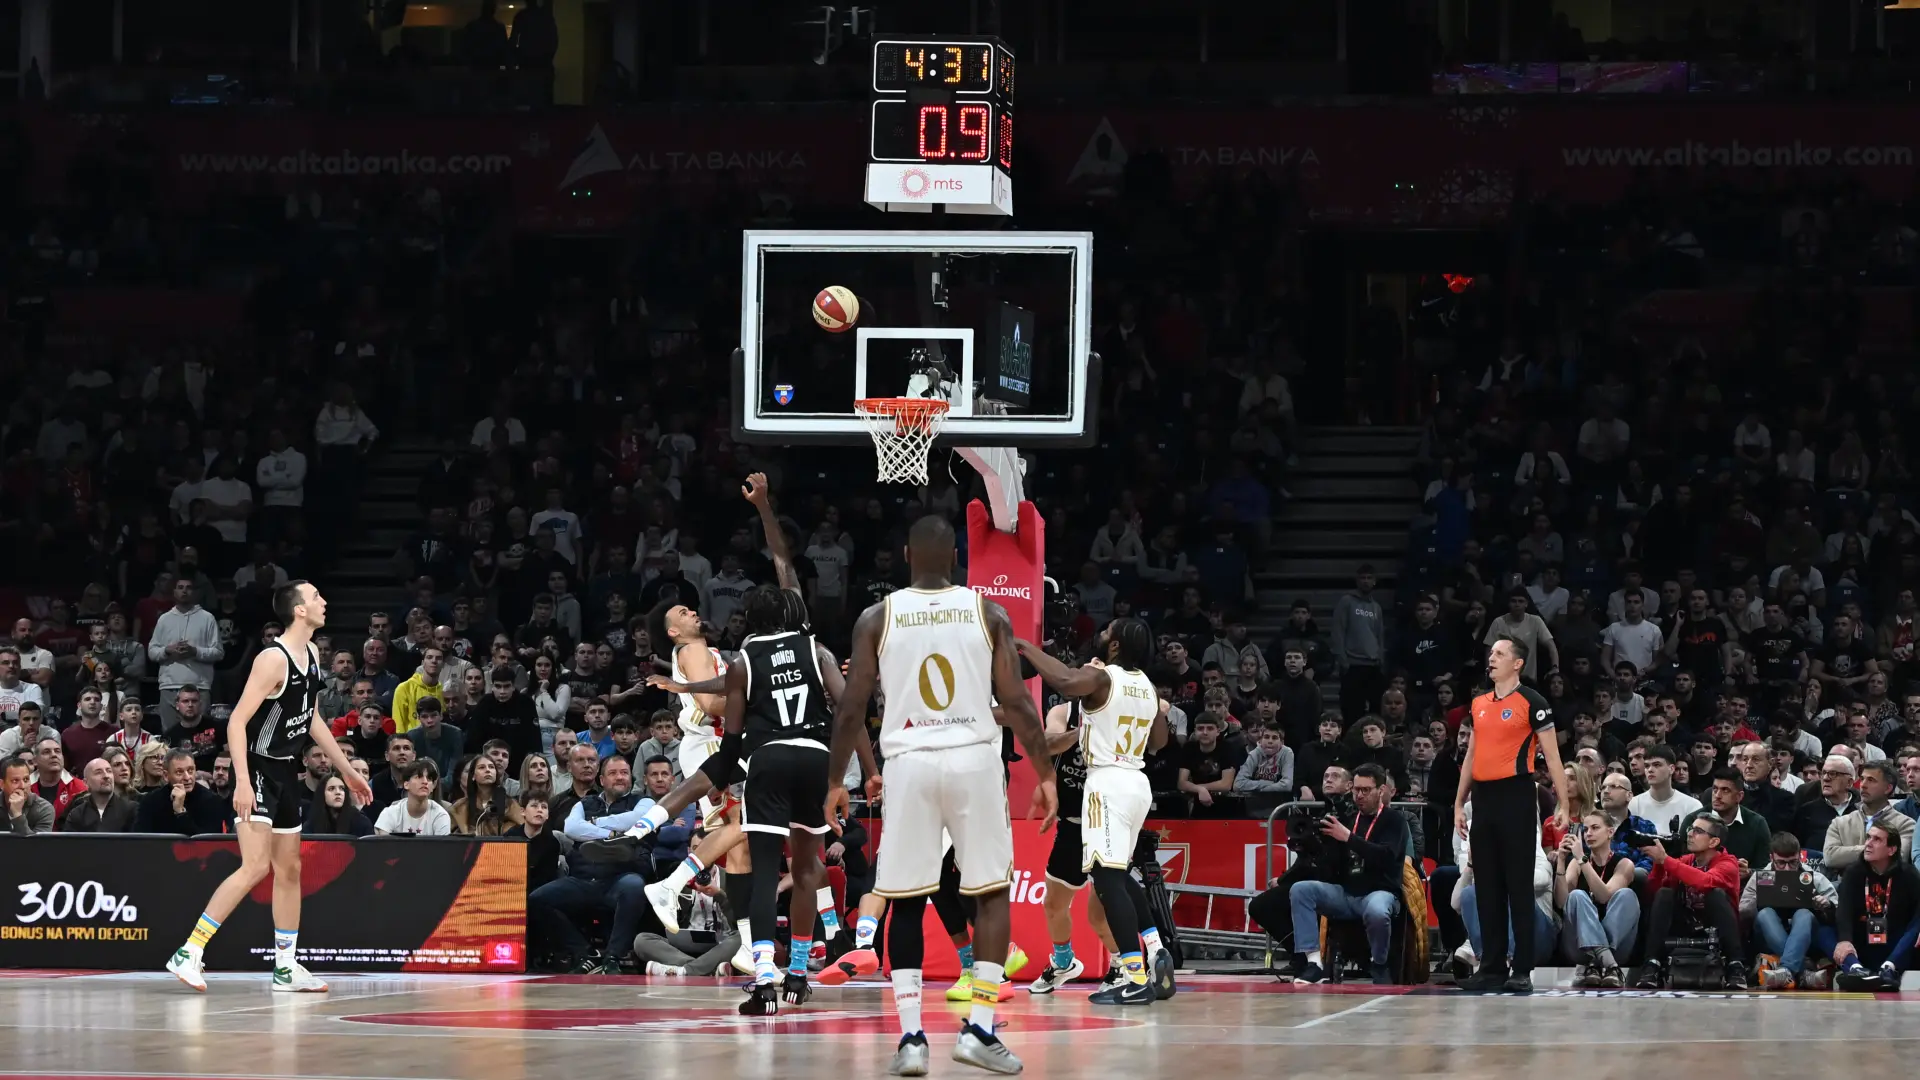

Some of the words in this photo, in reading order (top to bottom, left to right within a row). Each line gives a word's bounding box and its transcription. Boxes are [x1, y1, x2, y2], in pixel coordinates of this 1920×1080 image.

[905, 47, 988, 83] 4:31
[919, 105, 988, 158] 0.9
[178, 148, 512, 175] www.altabanka.com
[627, 150, 807, 170] ALTABANKA
[1561, 139, 1913, 167] www.altabanka.com
[934, 177, 963, 191] mts
[972, 585, 1032, 600] SPALDING
[895, 608, 975, 629] MILLER-MCINTYRE
[771, 649, 796, 668] BONGA
[771, 669, 803, 686] mts
[919, 653, 955, 711] 0
[771, 684, 809, 727] 17
[916, 716, 977, 727] ALTABANKA
[1115, 715, 1150, 757] 37
[15, 880, 138, 924] 300%
[0, 925, 44, 940] BONUS
[46, 926, 64, 940] NA
[66, 927, 95, 940] PRVI
[98, 927, 149, 941] DEPOZIT
